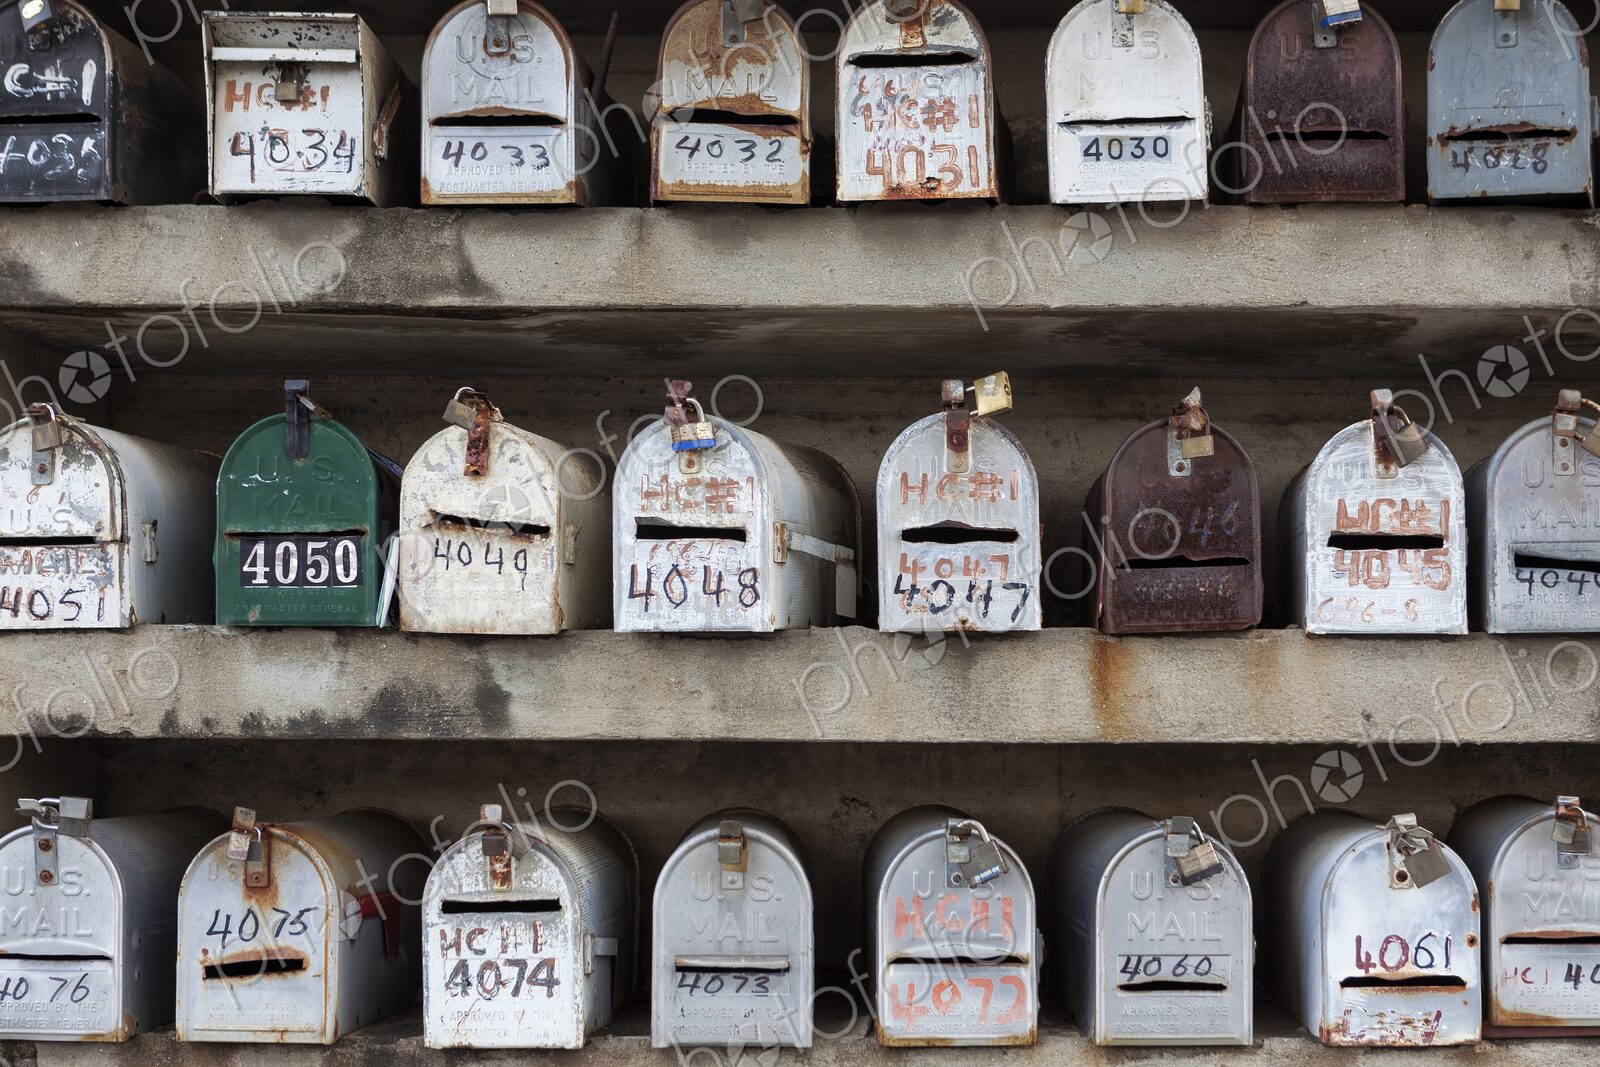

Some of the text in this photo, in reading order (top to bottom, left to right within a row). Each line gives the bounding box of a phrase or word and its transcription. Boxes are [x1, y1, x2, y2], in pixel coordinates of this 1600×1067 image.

[452, 74, 544, 104] MAIL
[686, 73, 777, 101] MAIL
[228, 128, 356, 183] 4034
[442, 140, 550, 170] 4033
[675, 135, 785, 163] 4032
[1083, 136, 1170, 161] 4030
[447, 164, 501, 176] APPROVED
[865, 144, 980, 190] 4031
[440, 181, 505, 192] POSTMASTER
[900, 470, 1019, 505] HC#1
[252, 495, 352, 522] MAIL
[242, 539, 358, 585] 4050
[434, 538, 527, 591] 4049
[900, 552, 1010, 585] 4047
[1333, 549, 1453, 591] 4045
[628, 562, 761, 613] 4048
[1515, 568, 1600, 595] 404
[0, 586, 106, 623] 4051
[310, 603, 358, 613] GENERAL
[893, 572, 1033, 624] 4047
[1508, 610, 1577, 622] POSTMASTER
[1, 906, 92, 938] MAIL
[206, 906, 319, 949] 4075
[686, 911, 779, 943] MAIL
[1127, 911, 1222, 942] MAIL
[1120, 954, 1213, 982] 4060
[1355, 931, 1453, 975] 4061
[444, 957, 561, 1000] 4074
[677, 972, 771, 996] 4073
[56, 1002, 69, 1013] BY
[77, 1002, 97, 1013] THE
[678, 1007, 735, 1019] APPROVED
[891, 975, 1033, 1029] 4072
[1122, 1005, 1229, 1017] APPROVED BY THE
[897, 1023, 966, 1034] POSTMASTER
[1115, 1022, 1183, 1033] POSTMASTER
